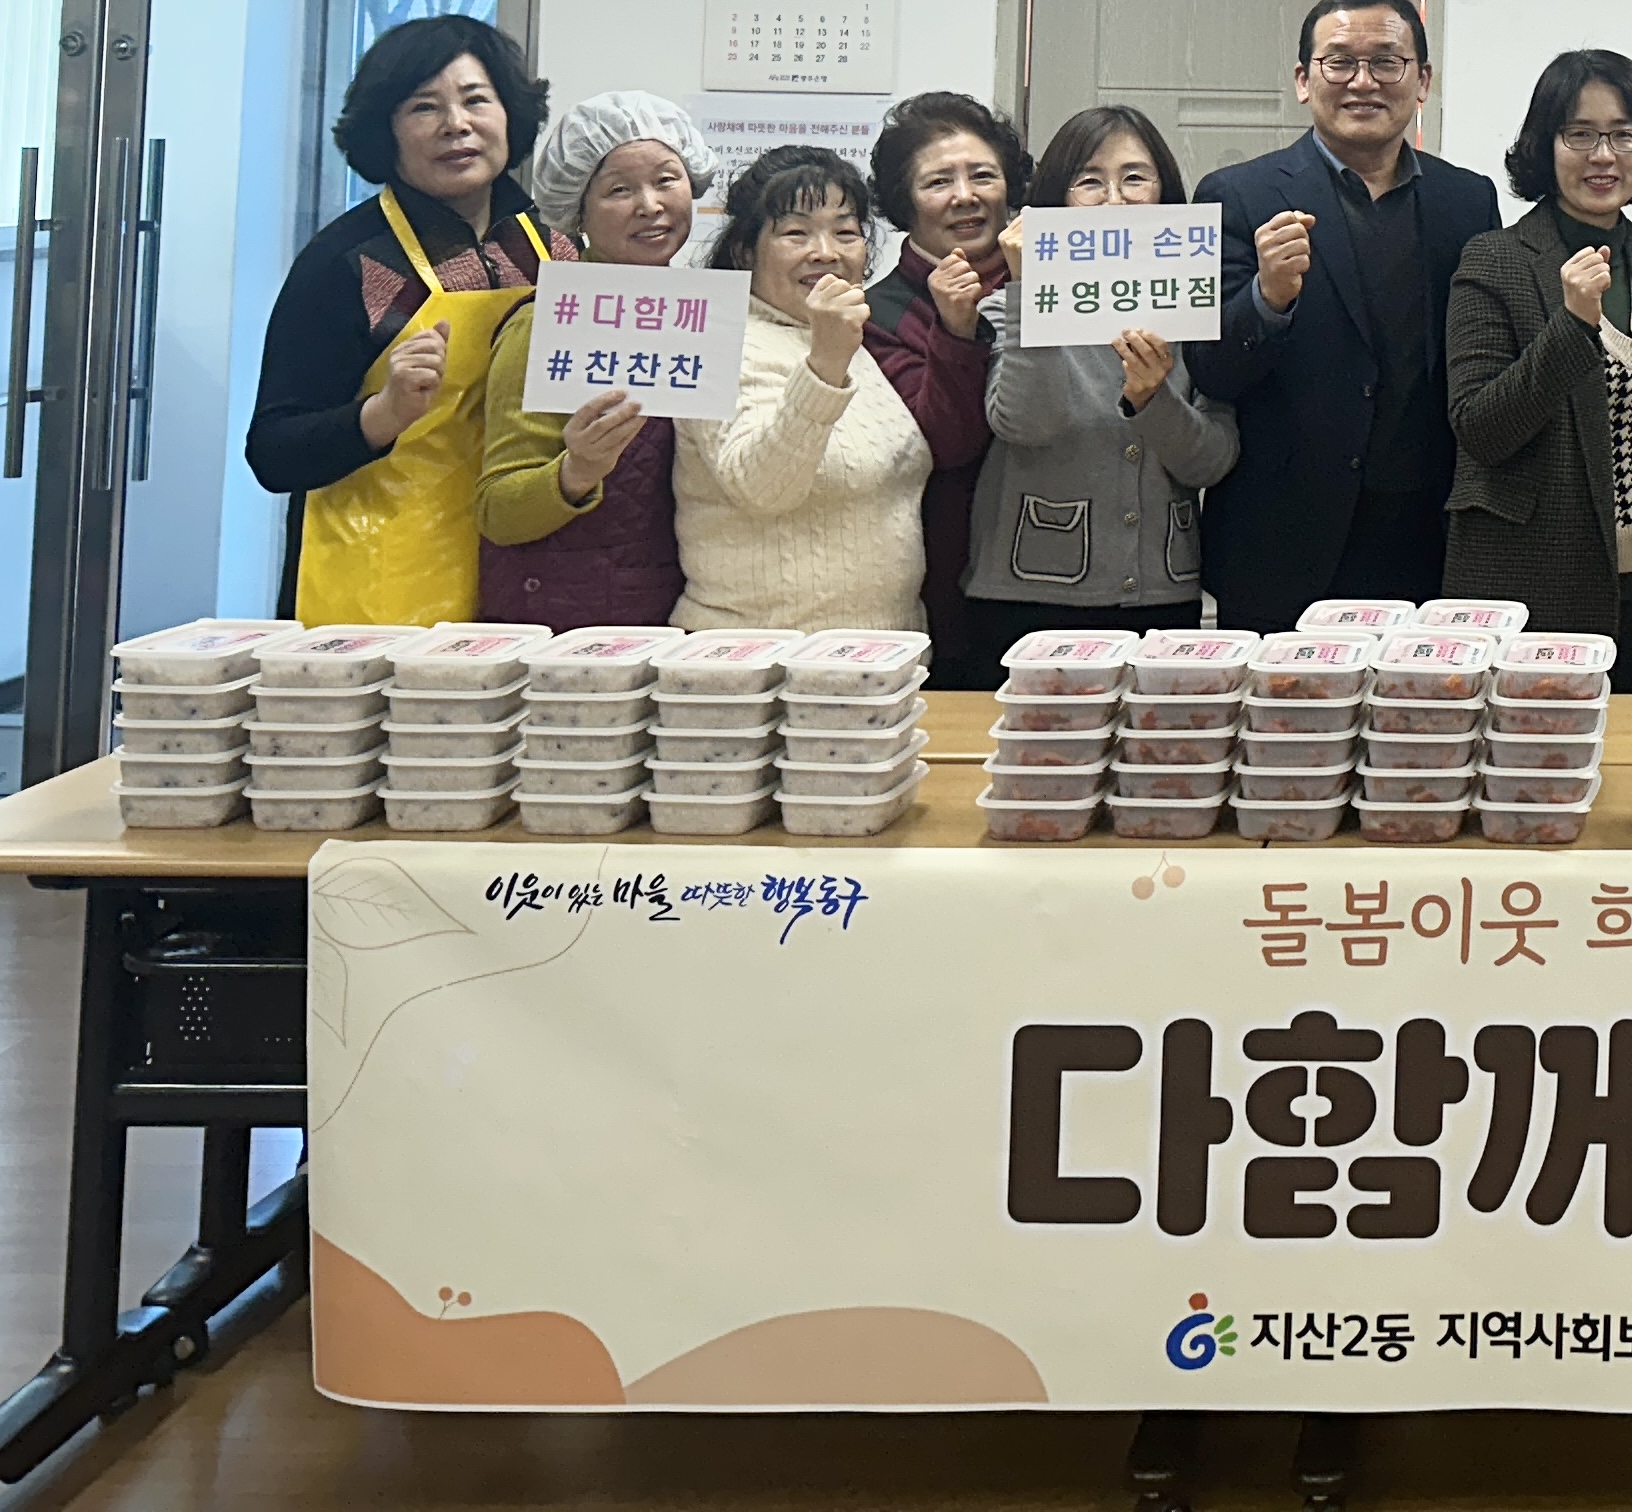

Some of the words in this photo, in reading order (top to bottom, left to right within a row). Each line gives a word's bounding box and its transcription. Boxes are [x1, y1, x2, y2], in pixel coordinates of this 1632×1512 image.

[708, 121, 745, 133] 사랑채에
[747, 122, 777, 133] 따뜻한
[779, 123, 807, 134] 마음을
[810, 124, 848, 135] 전해주신
[851, 124, 870, 135] 분들
[1034, 227, 1133, 262] #엄마
[1153, 225, 1218, 258] 손맛
[553, 293, 708, 333] #다함께
[1034, 276, 1216, 314] #영양만점
[546, 349, 703, 389] #찬찬찬
[485, 872, 564, 921] 이웃이
[567, 882, 604, 914] 있는
[612, 872, 681, 922] 마을
[680, 880, 755, 912] 따뜻한
[1242, 879, 1563, 971] 돌봄이웃
[1250, 1312, 1415, 1363] 지산2동
